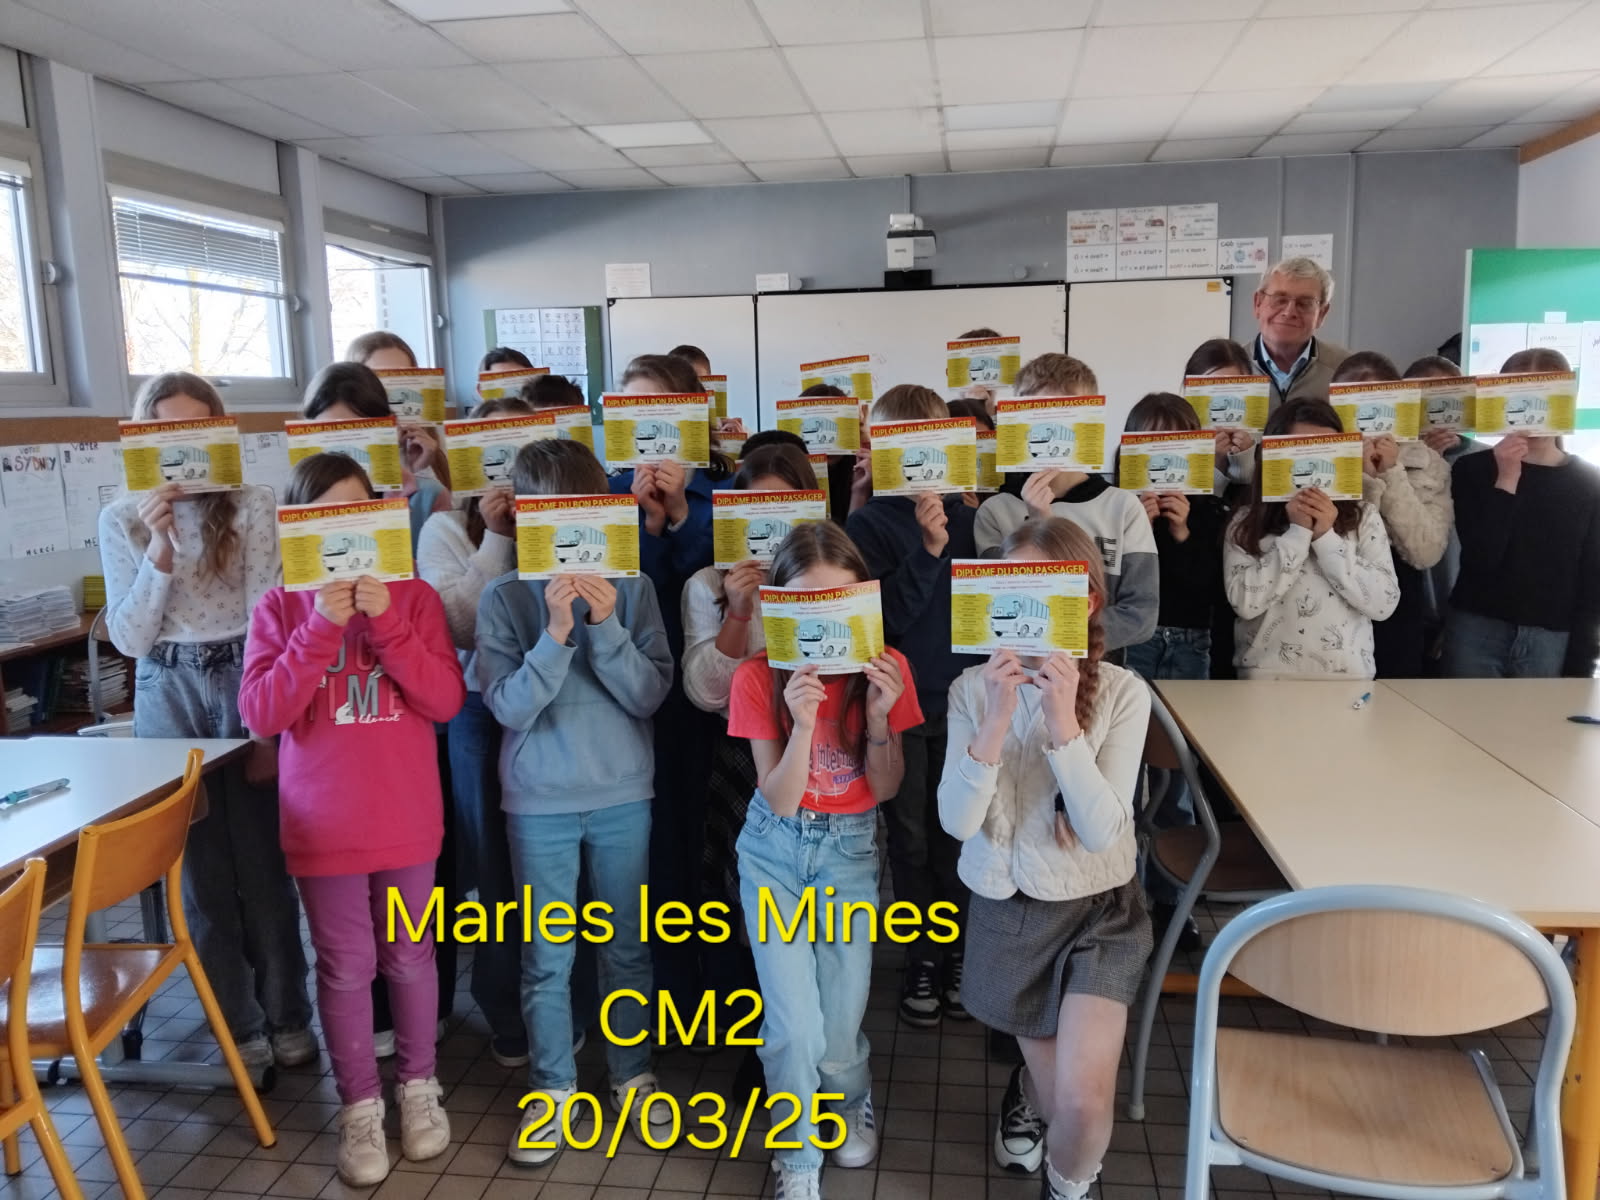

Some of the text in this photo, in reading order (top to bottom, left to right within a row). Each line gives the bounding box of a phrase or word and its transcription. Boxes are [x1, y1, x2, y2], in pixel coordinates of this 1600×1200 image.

[668, 396, 705, 404] PASSAGER
[1046, 400, 1061, 408] BON
[1062, 398, 1103, 406] PASSAGER
[918, 424, 933, 432] BON
[935, 420, 971, 430] PASSAGER
[574, 500, 591, 508] BON
[593, 498, 635, 506] PASSAGER
[783, 494, 822, 502] PASSAGER
[324, 509, 337, 517] DU
[340, 507, 359, 516] BON
[360, 502, 406, 513] PASSAGER
[956, 565, 1085, 577] DIPLÔME DU BON PASSAGER
[815, 592, 833, 601] BON
[836, 584, 877, 599] PASSAGER
